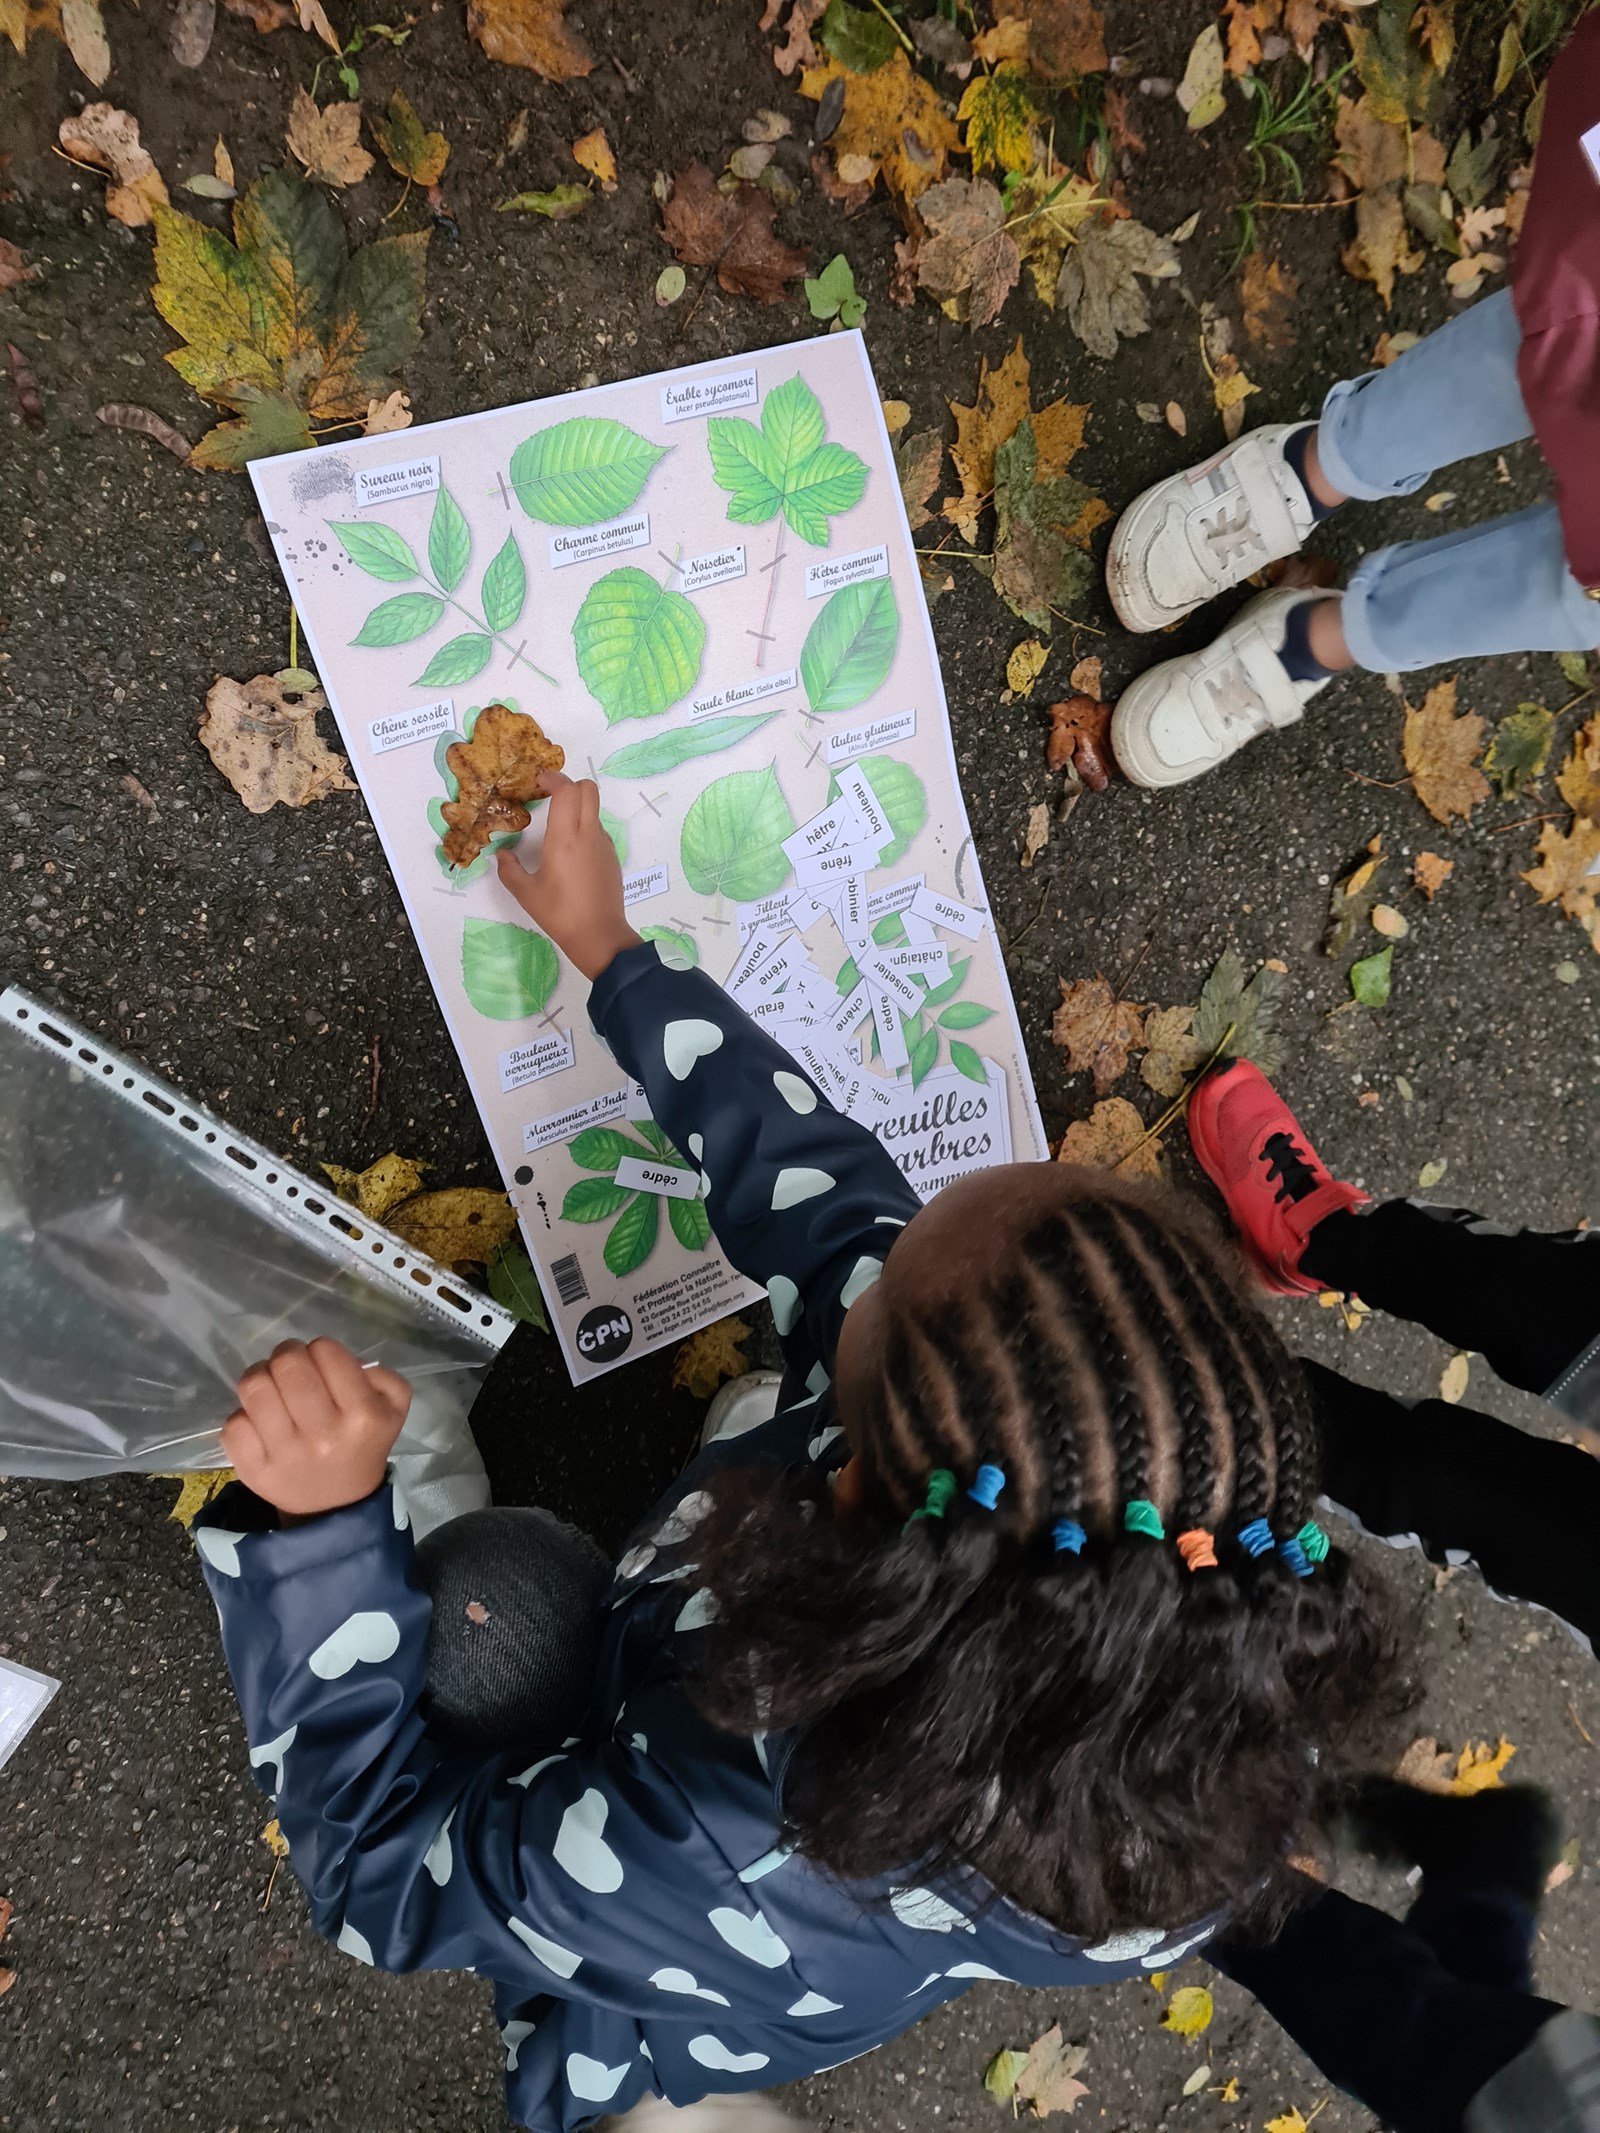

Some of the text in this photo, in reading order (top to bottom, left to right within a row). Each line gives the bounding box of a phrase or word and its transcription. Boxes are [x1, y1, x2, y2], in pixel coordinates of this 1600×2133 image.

[666, 377, 755, 405] Érable sycomore
[676, 389, 750, 415] (Acer pseudoplatanus)
[360, 462, 433, 489] Sureau noir
[368, 476, 433, 500] (Sambucus nigra)
[554, 521, 646, 552] Charme commun
[573, 535, 634, 560] (Carpinus betulus)
[684, 563, 743, 588] (Corylus avellana)
[689, 554, 736, 575] Noisetier
[810, 552, 884, 581] Hêtre commun
[823, 566, 875, 589] (Fagus sylvatica)
[693, 676, 791, 714] Saule blanc (Salix alba)
[372, 704, 450, 737] Chêne sessile
[381, 719, 448, 747] (Quercus petraea)
[831, 717, 912, 749] Aulne glutineux
[848, 730, 900, 754] (Alnus glutinosa)
[852, 782, 882, 835] bouleau
[806, 819, 836, 845] hêtre
[820, 855, 852, 871] frêne
[622, 872, 664, 891] nogyne
[624, 887, 651, 900] nogyna)
[755, 894, 790, 916] Tilleul
[848, 877, 860, 924] obinier
[935, 902, 966, 922] cèdre
[759, 957, 788, 985] frêne
[890, 950, 943, 966] châtaign
[873, 961, 915, 1000] noisetier
[749, 1001, 785, 1017] érabl
[836, 997, 863, 1032] chêne
[881, 995, 894, 1032] cèdre
[505, 1046, 569, 1077] verruqueux
[510, 1040, 559, 1064] Bouleau
[512, 1057, 568, 1085] (Betula pendula)
[526, 1109, 589, 1139] Marronnier
[537, 1105, 622, 1145] (Aesculus hippocastanum)
[894, 1130, 991, 1174] arbres
[642, 1170, 678, 1187] cèdre
[633, 1259, 721, 1305] Fédération Connaître
[636, 1270, 723, 1314] et Protéger la Nature
[650, 1305, 676, 1319] Grande
[676, 1298, 690, 1309] Rue
[579, 1315, 631, 1352] CPN
